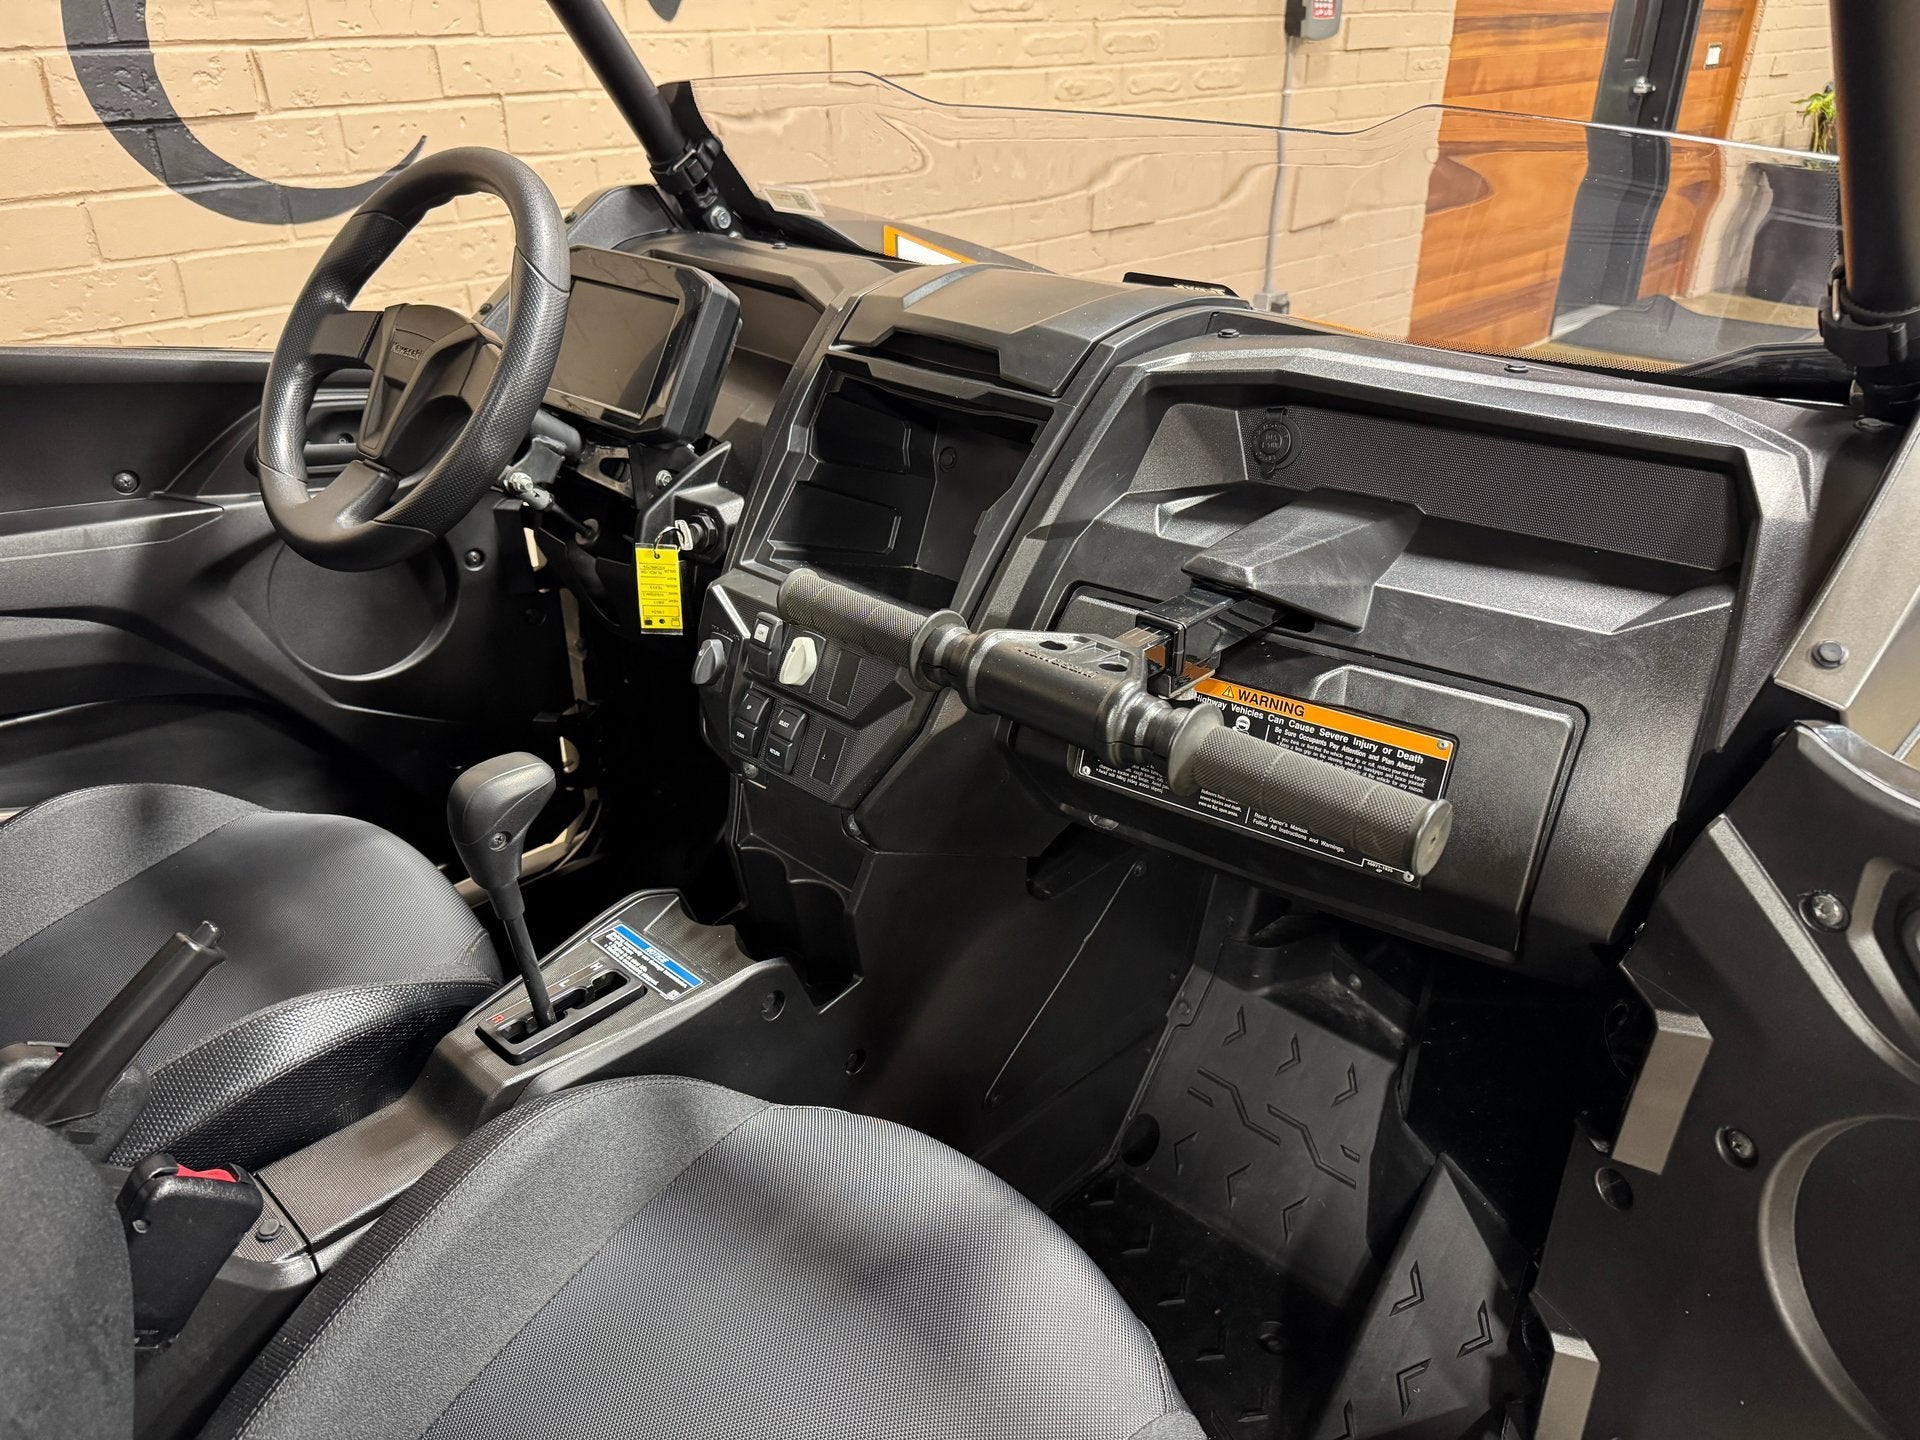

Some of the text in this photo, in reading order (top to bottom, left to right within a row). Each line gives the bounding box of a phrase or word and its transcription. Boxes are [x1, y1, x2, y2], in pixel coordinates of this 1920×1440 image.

[1238, 689, 1305, 718] WARNING
[1231, 703, 1264, 720] Vehicles
[1267, 714, 1285, 725] Can
[1288, 719, 1315, 734] Cause
[1319, 728, 1349, 743] Severe
[1353, 737, 1378, 753] Injury
[1382, 746, 1393, 755] or
[1396, 750, 1424, 764] Death
[1274, 726, 1416, 772] Be Sure Occupants Pay Attention and Plan Ahead
[1252, 818, 1268, 828] Follow
[1279, 827, 1307, 840] Instructions
[1308, 836, 1319, 844] and
[1320, 840, 1345, 853] Warnings.
[1254, 812, 1267, 821] Read
[1268, 817, 1288, 828] Owner's
[590, 962, 603, 971] H
